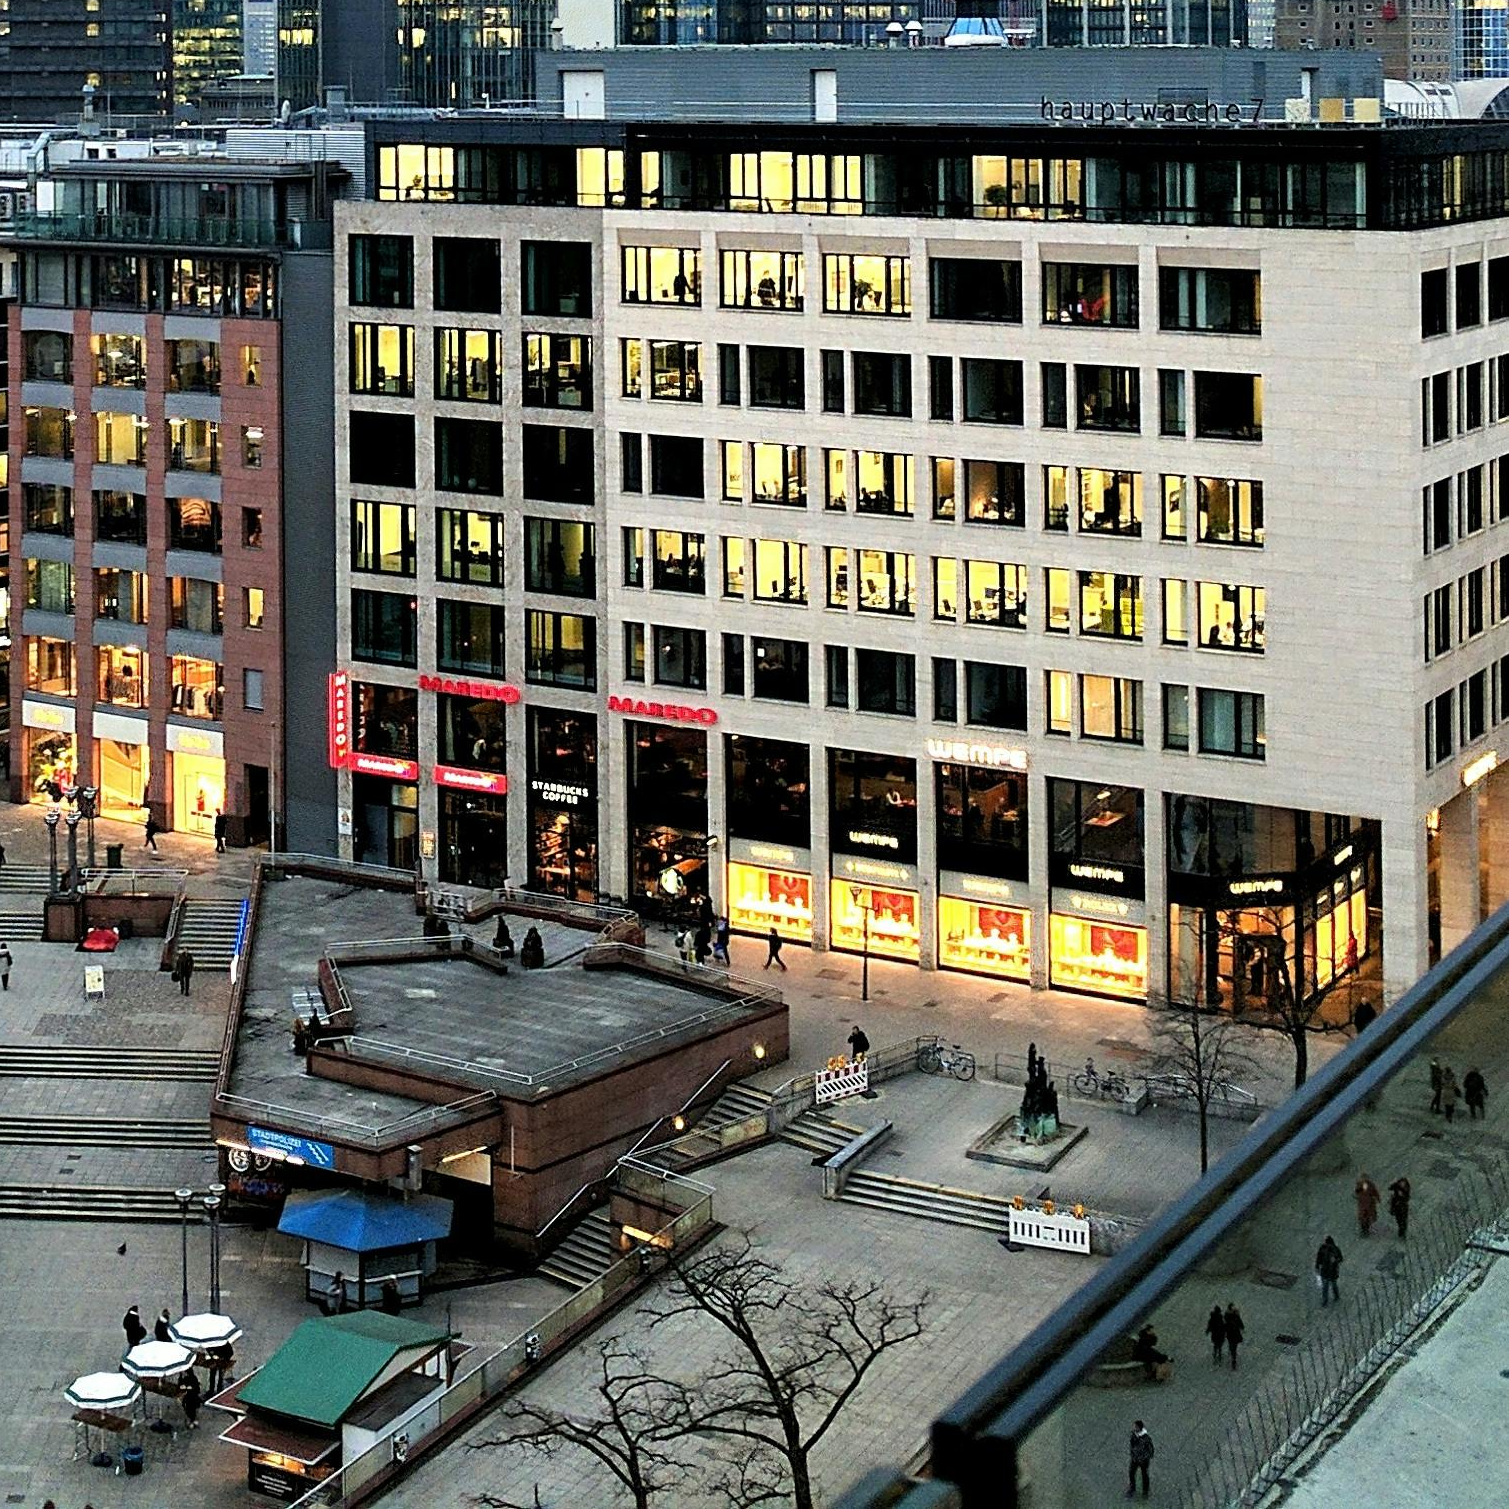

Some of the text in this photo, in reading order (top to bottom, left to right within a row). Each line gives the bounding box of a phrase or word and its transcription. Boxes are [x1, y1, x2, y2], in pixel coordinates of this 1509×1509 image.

[419, 674, 520, 705] MAREDO
[335, 674, 347, 746] MAREDO
[608, 695, 718, 727] MAREDO
[927, 738, 1028, 770] WEMPE
[532, 780, 589, 798] STARBUCKS
[542, 790, 579, 805] COFFEE
[849, 830, 899, 849] WEMPE
[1070, 864, 1124, 883] WEMPE
[1229, 880, 1283, 895] WEMPE
